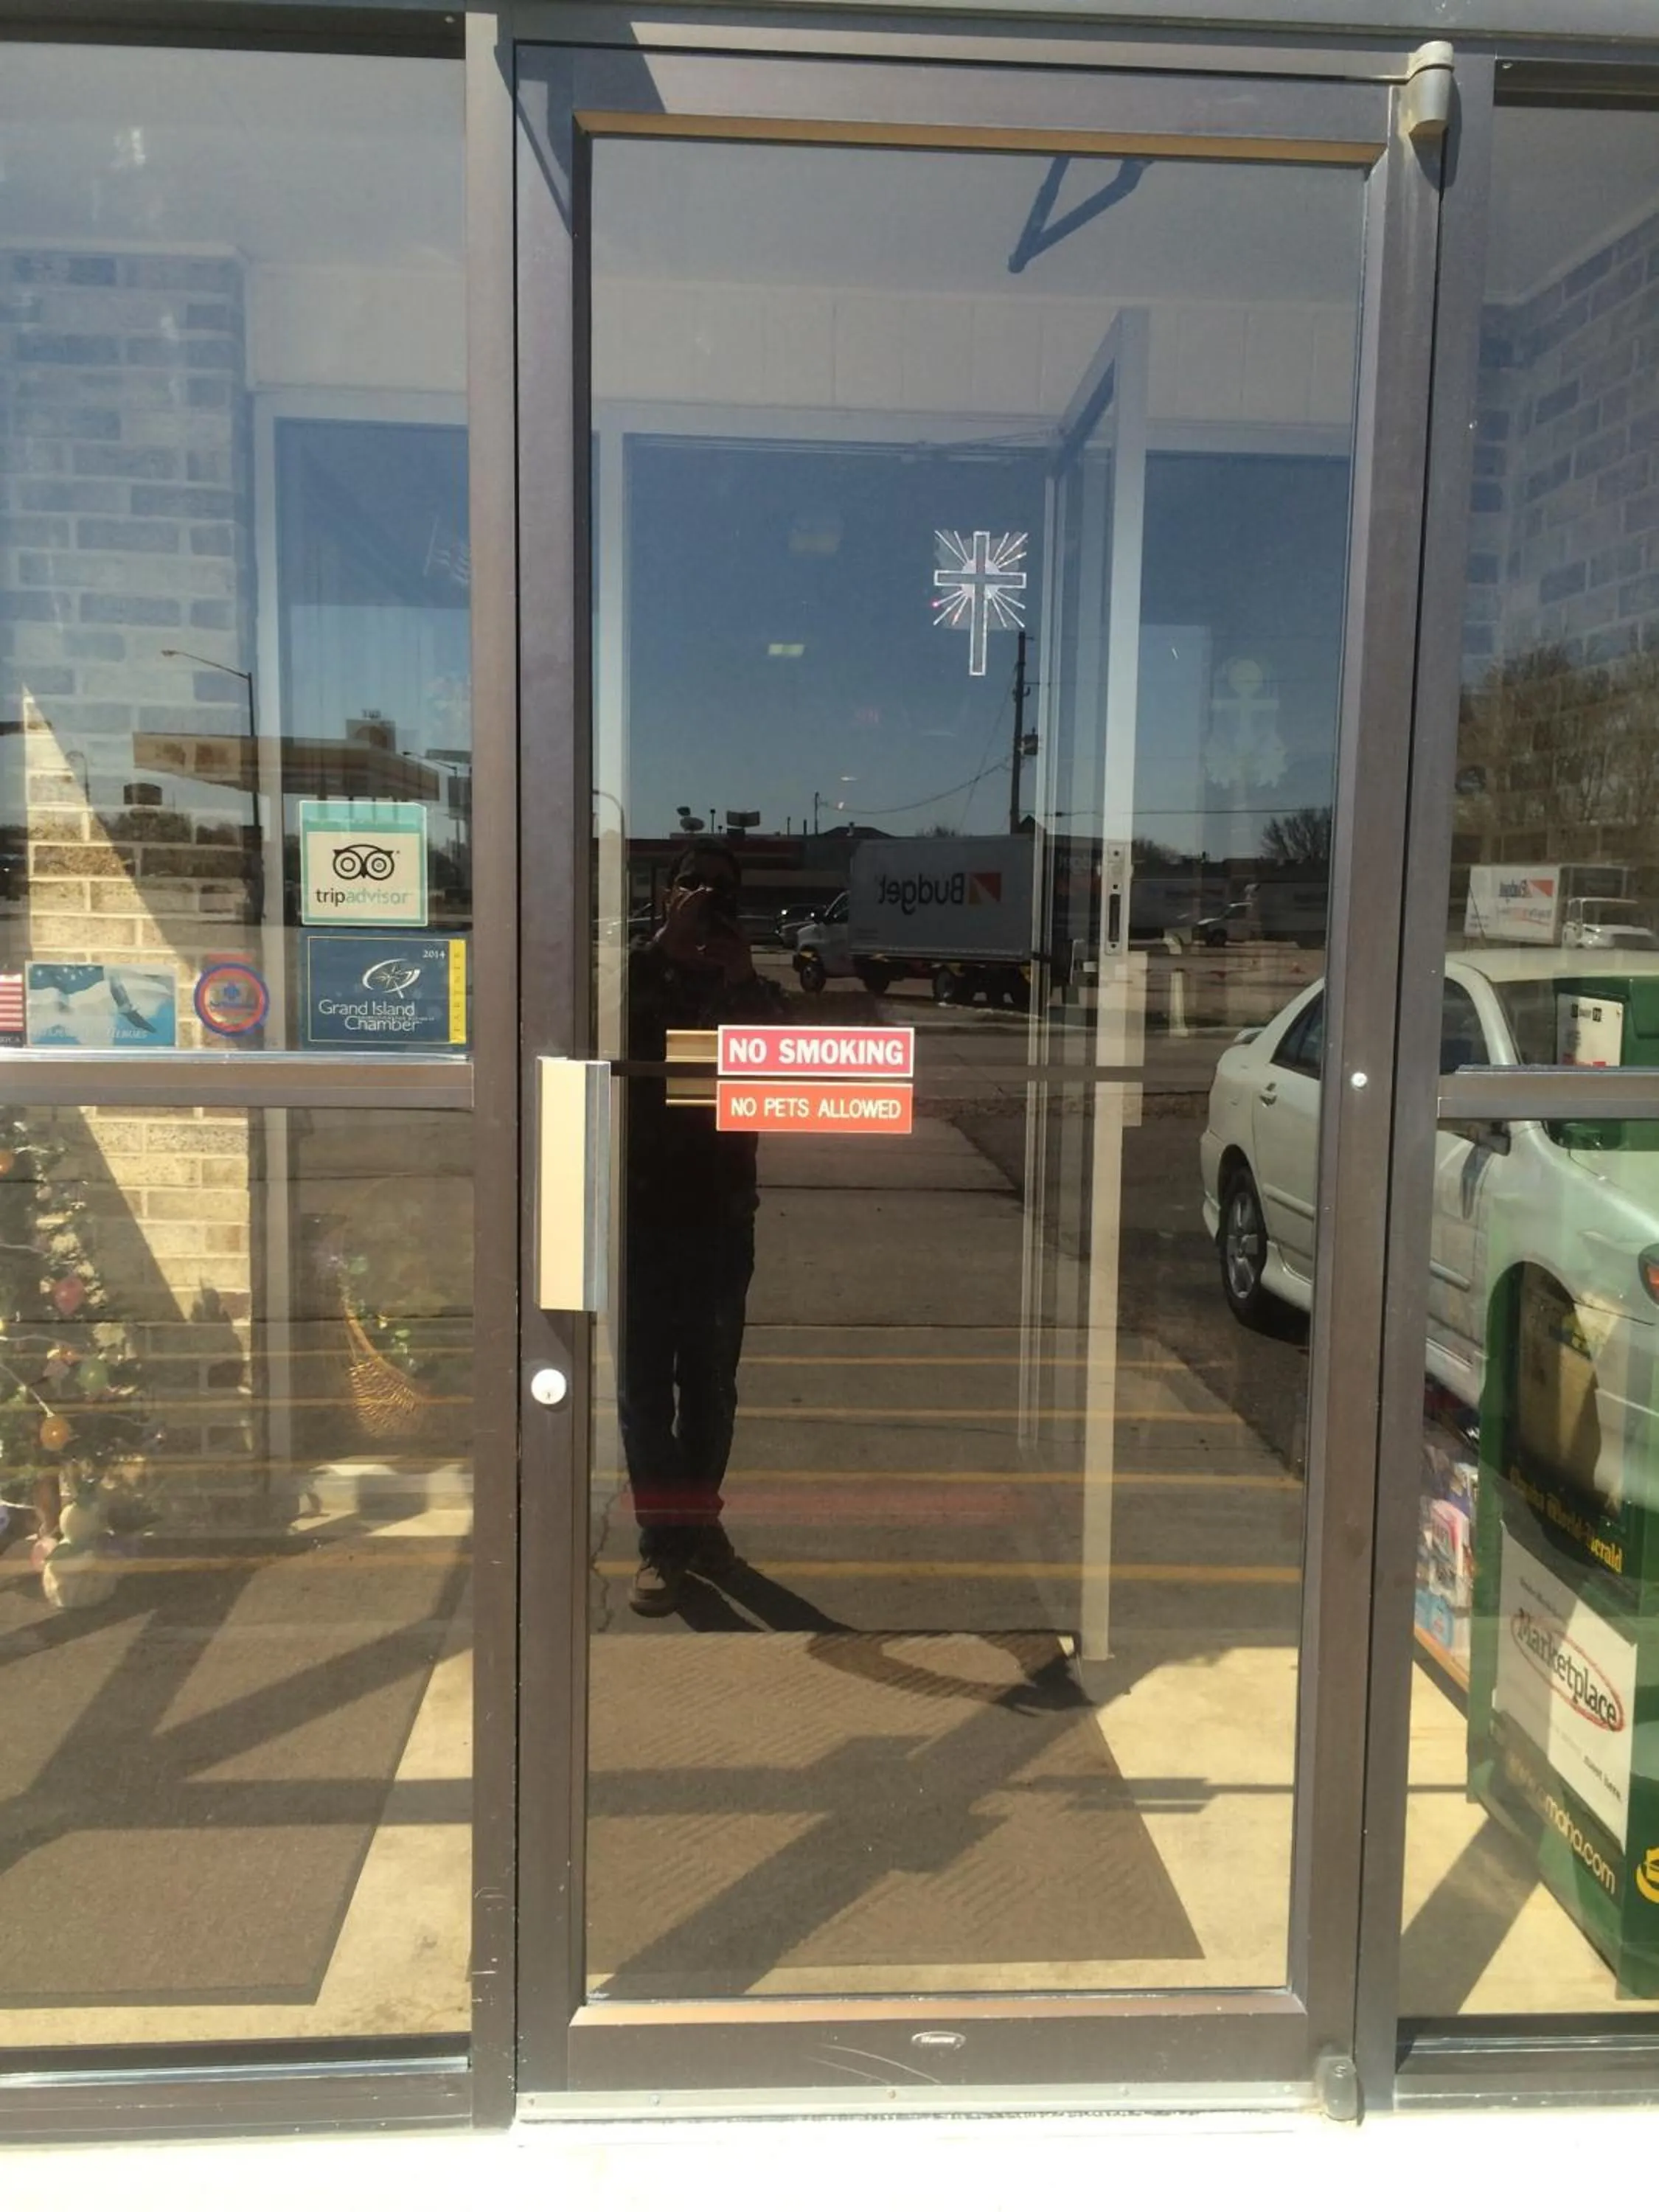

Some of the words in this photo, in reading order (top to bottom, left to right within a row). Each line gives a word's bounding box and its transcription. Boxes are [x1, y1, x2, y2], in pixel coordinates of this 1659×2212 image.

[315, 887, 409, 908] tripadvisor
[422, 949, 446, 959] 2014
[318, 998, 368, 1015] Grand
[372, 1000, 416, 1017] Island
[344, 1015, 419, 1032] Chamber
[728, 1037, 768, 1063] NO
[778, 1038, 904, 1065] SMOKING
[730, 1096, 757, 1117] NO
[763, 1097, 810, 1119] PETS
[817, 1098, 902, 1119] ALLOWED
[1516, 1607, 1618, 1726] Marketplace
